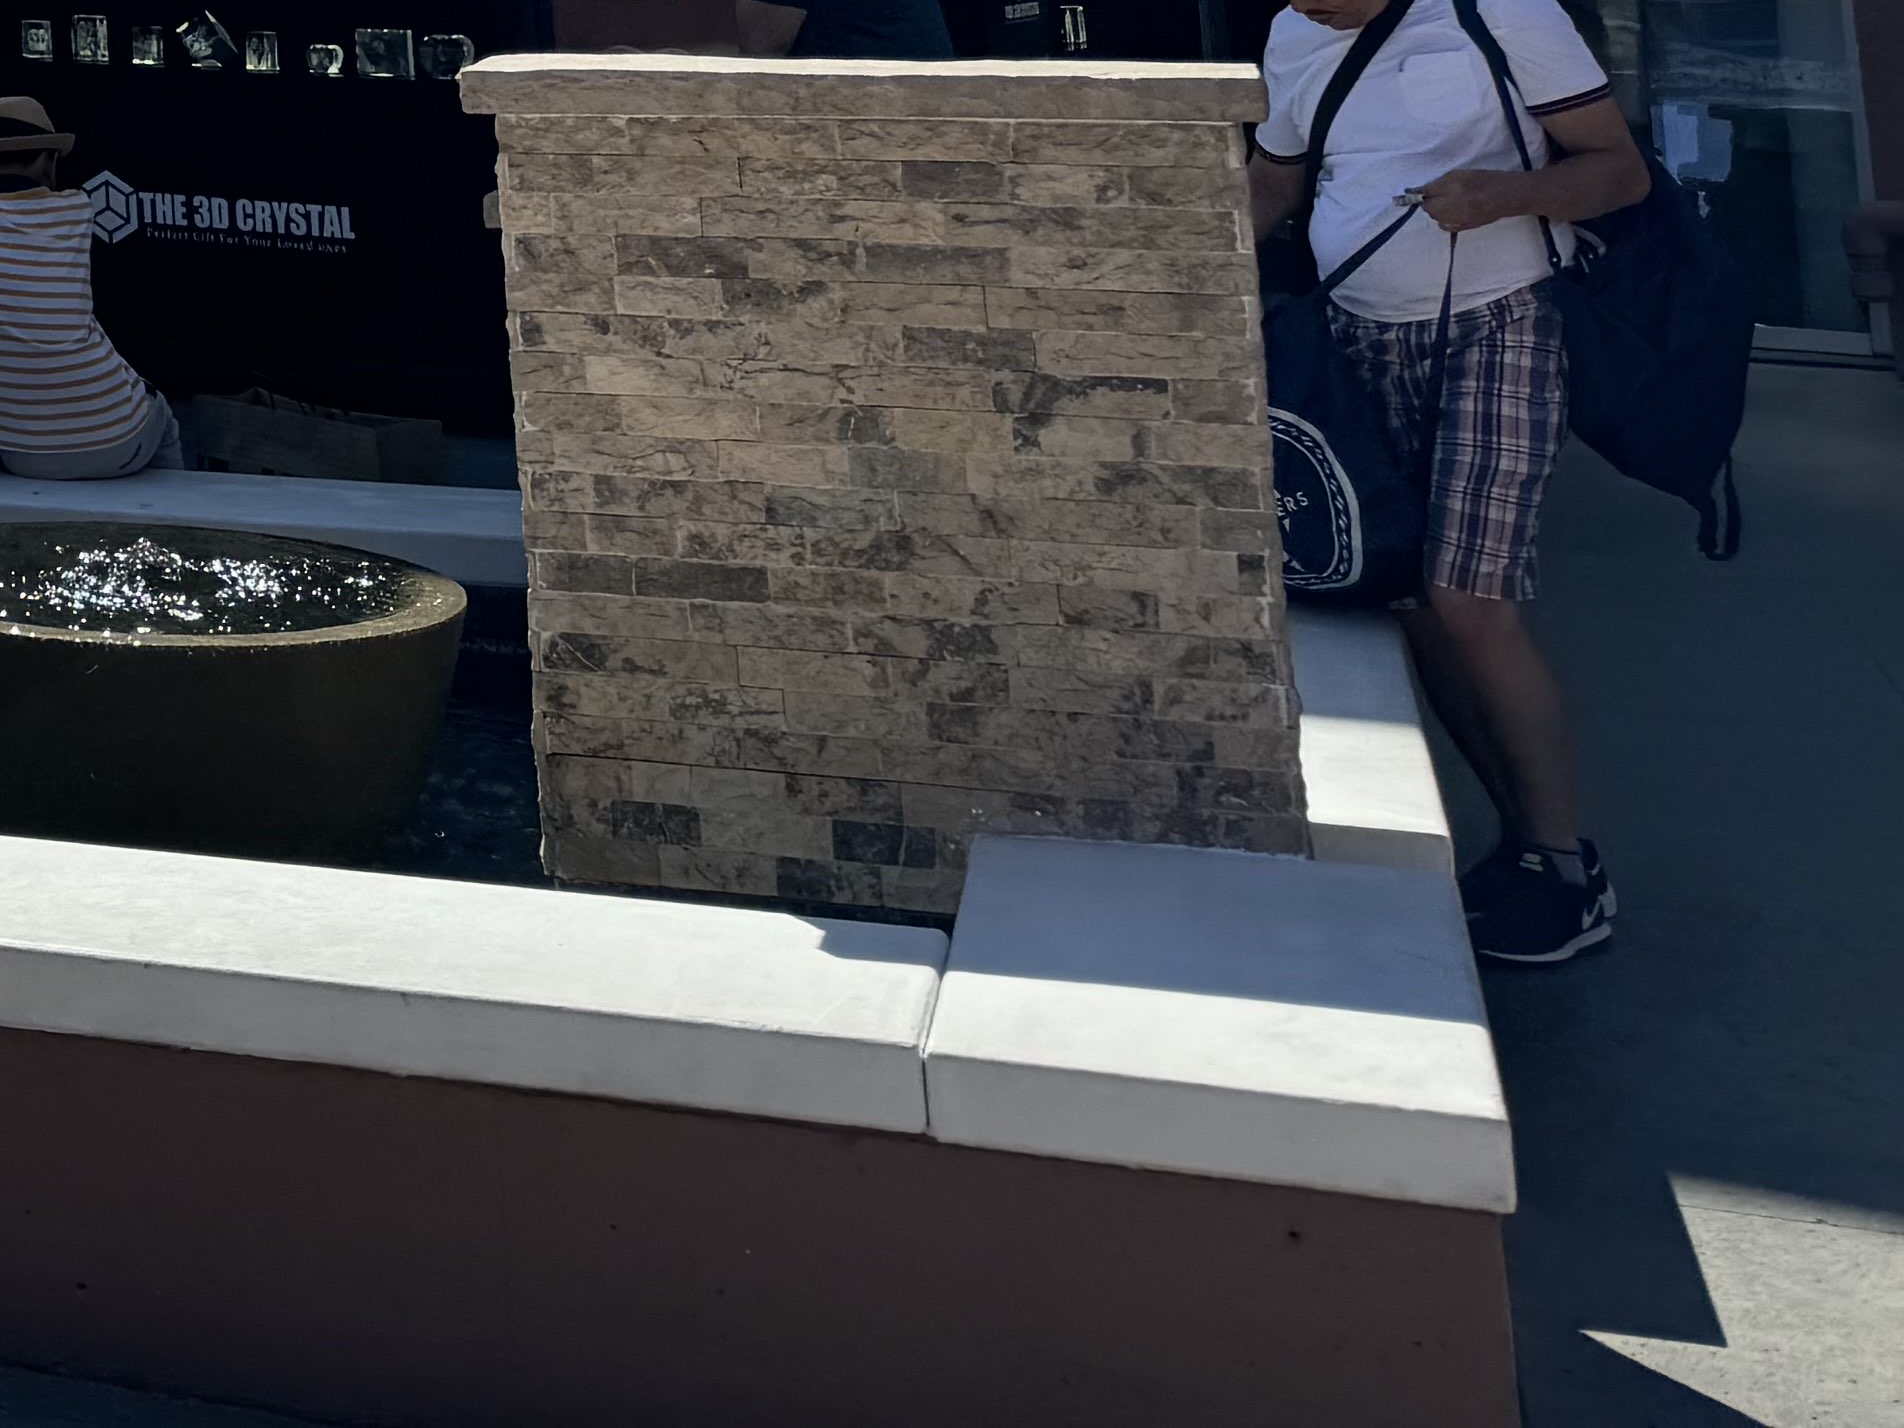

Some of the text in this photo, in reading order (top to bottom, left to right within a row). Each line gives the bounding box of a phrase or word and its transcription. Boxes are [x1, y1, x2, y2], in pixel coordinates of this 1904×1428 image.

[139, 192, 355, 240] THE 3D CRYSTAL
